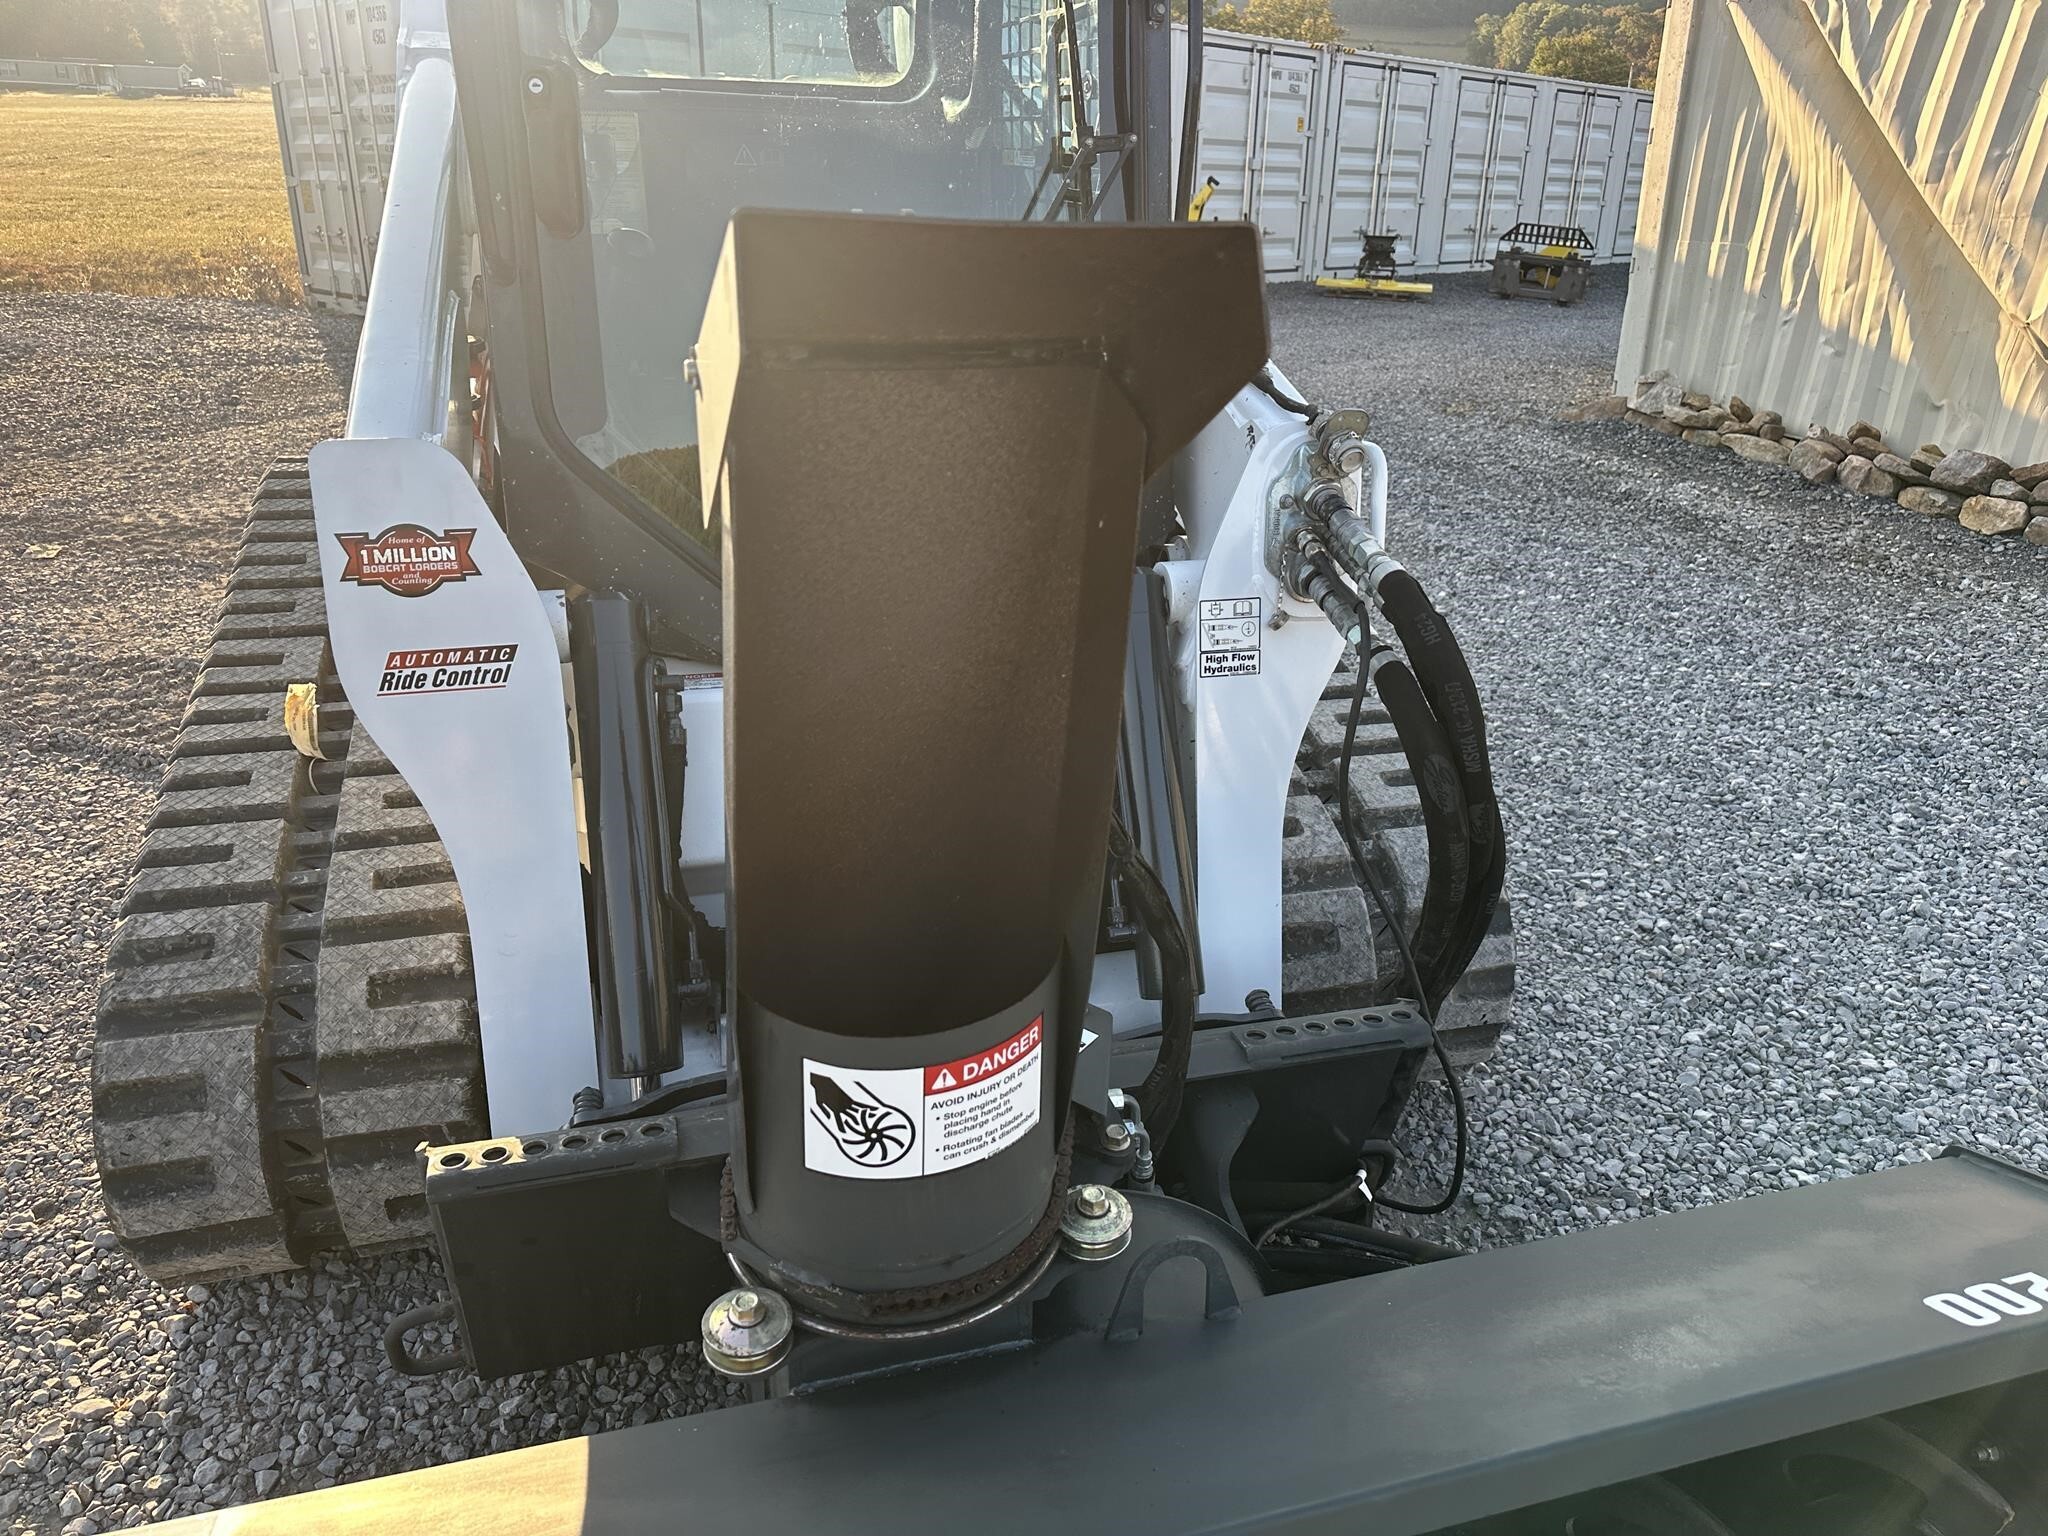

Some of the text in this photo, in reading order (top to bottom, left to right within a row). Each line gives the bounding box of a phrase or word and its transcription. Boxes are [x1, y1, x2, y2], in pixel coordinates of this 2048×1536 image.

[360, 546, 456, 564] 1 MILLION
[363, 562, 458, 573] BOBCAT LOADERS
[392, 577, 433, 585] Counting
[390, 647, 510, 667] AUTOMATIC
[1203, 664, 1257, 674] Hydraulics
[1205, 653, 1255, 664] High Flow
[379, 663, 512, 691] Ride Control
[963, 1025, 1039, 1080] DANGER
[931, 1053, 1039, 1110] AVOID INJURY OR DEATH
[943, 1082, 1023, 1121] Stop engine before
[943, 1098, 1011, 1130] placing hand in
[943, 1106, 1013, 1138] discharge chute
[943, 1135, 983, 1152] Rotating
[985, 1128, 998, 1139] fan
[1000, 1112, 1023, 1130] blades
[943, 1151, 961, 1161] can
[963, 1140, 989, 1155] crush
[990, 1136, 997, 1144] &
[998, 1109, 1036, 1140] dismember
